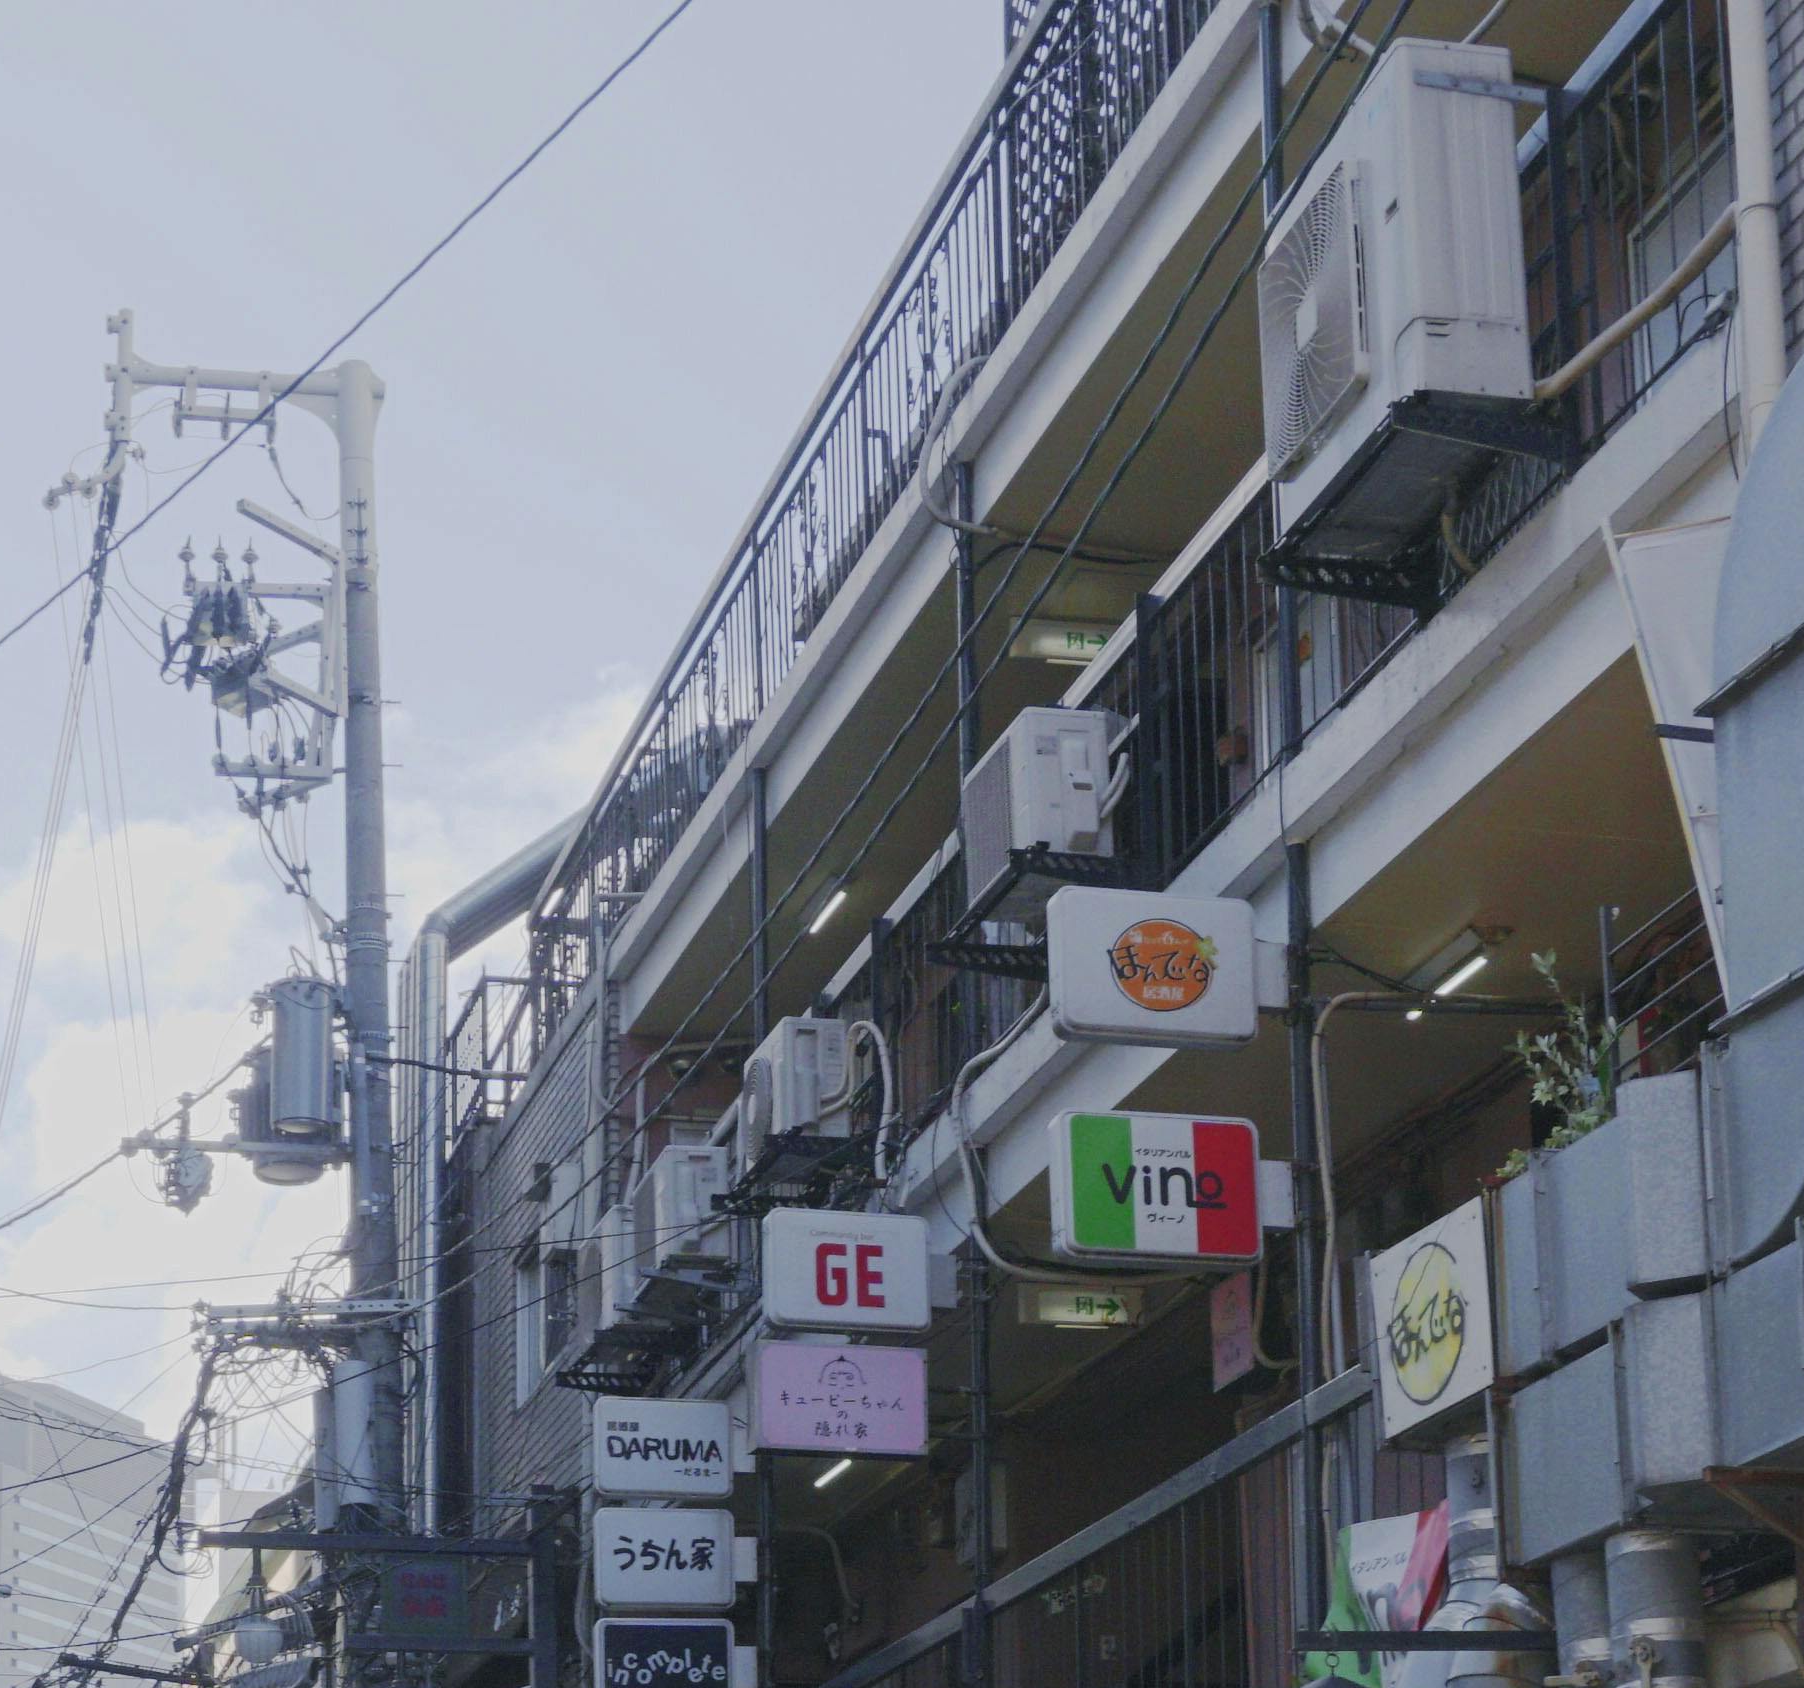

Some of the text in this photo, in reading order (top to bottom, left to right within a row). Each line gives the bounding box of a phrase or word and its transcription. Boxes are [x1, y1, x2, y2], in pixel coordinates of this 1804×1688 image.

[1106, 945, 1210, 984] ほんでな
[1146, 1212, 1186, 1224] ヴィーノ
[815, 1242, 886, 1308] GE
[1387, 1289, 1468, 1367] ほんでな
[814, 1420, 868, 1439] 隠れ家
[837, 1410, 848, 1420] の
[605, 1435, 723, 1462] DARUMA
[613, 1535, 716, 1572] うちん家
[606, 1647, 726, 1686] incomplete
